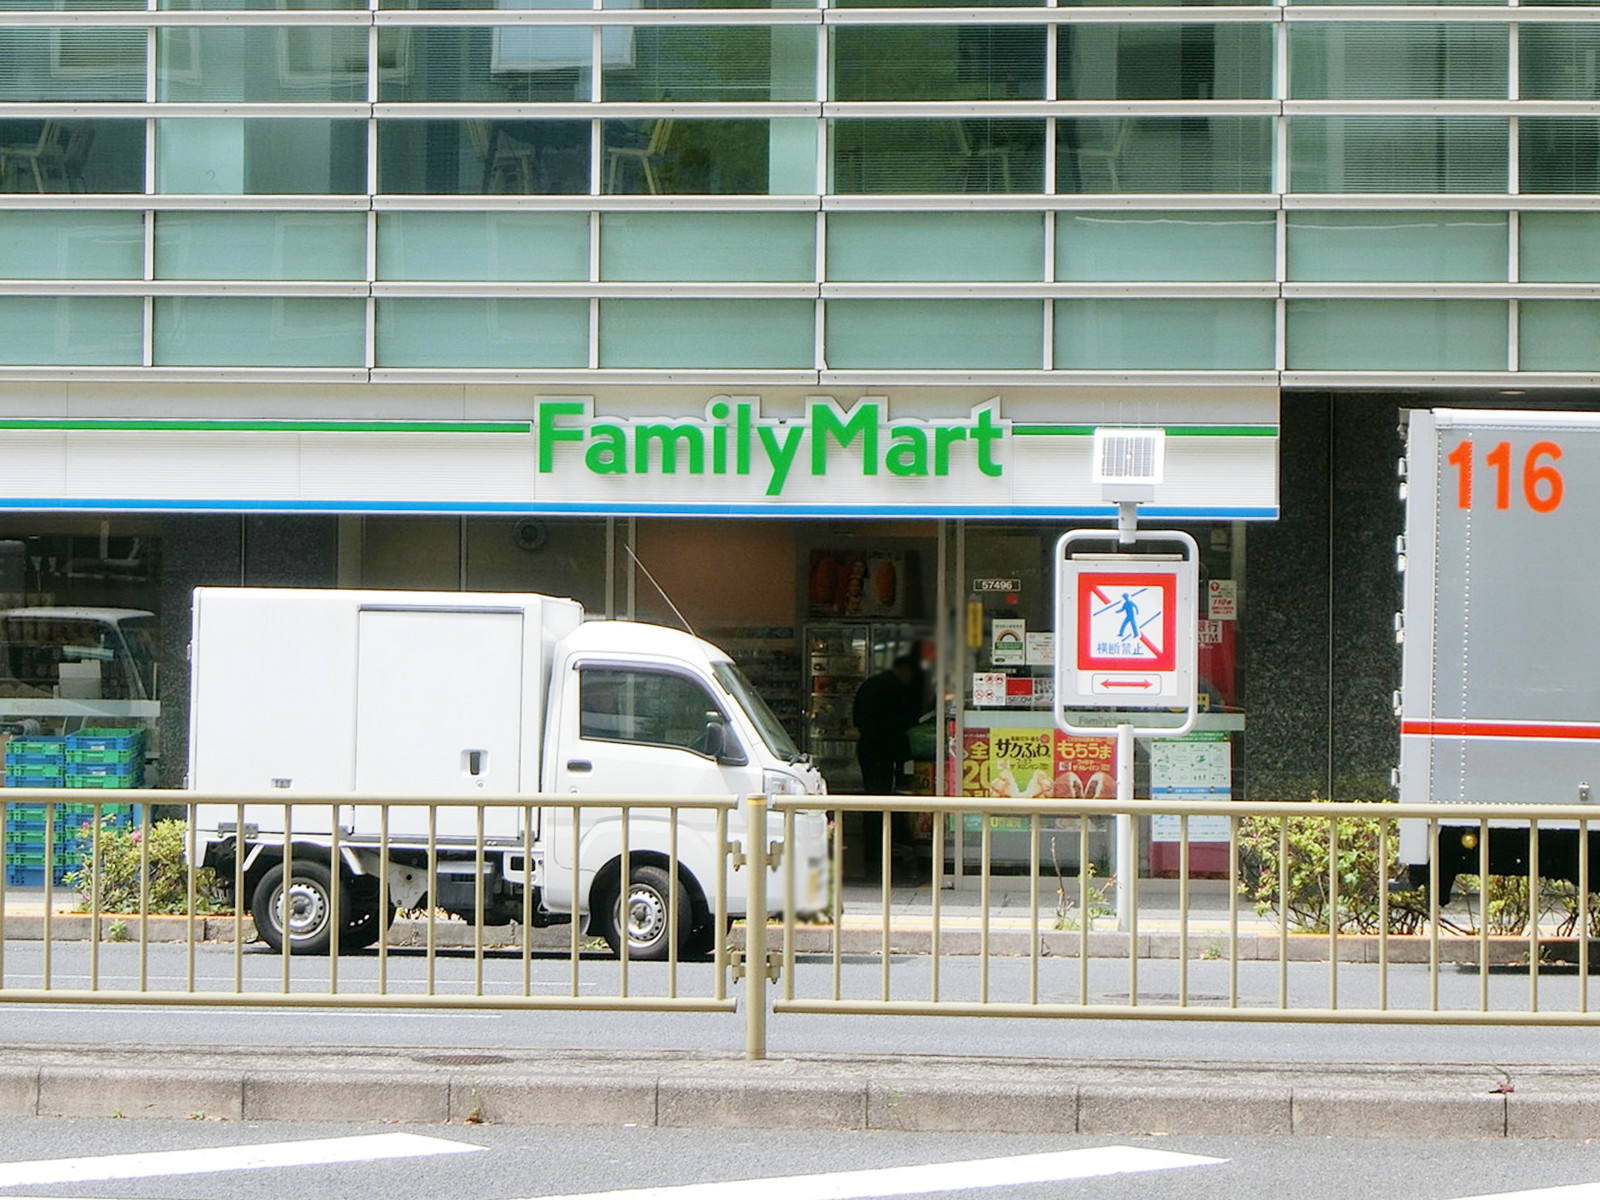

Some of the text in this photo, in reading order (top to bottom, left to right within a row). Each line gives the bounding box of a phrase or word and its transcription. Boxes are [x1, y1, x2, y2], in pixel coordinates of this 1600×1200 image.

[539, 403, 1003, 495] FamilyMart
[1448, 440, 1564, 513] 116
[982, 581, 1013, 591] 57496
[1097, 641, 1144, 656] 横断禁止
[970, 741, 989, 760] 全
[1057, 739, 1112, 760] もちうま
